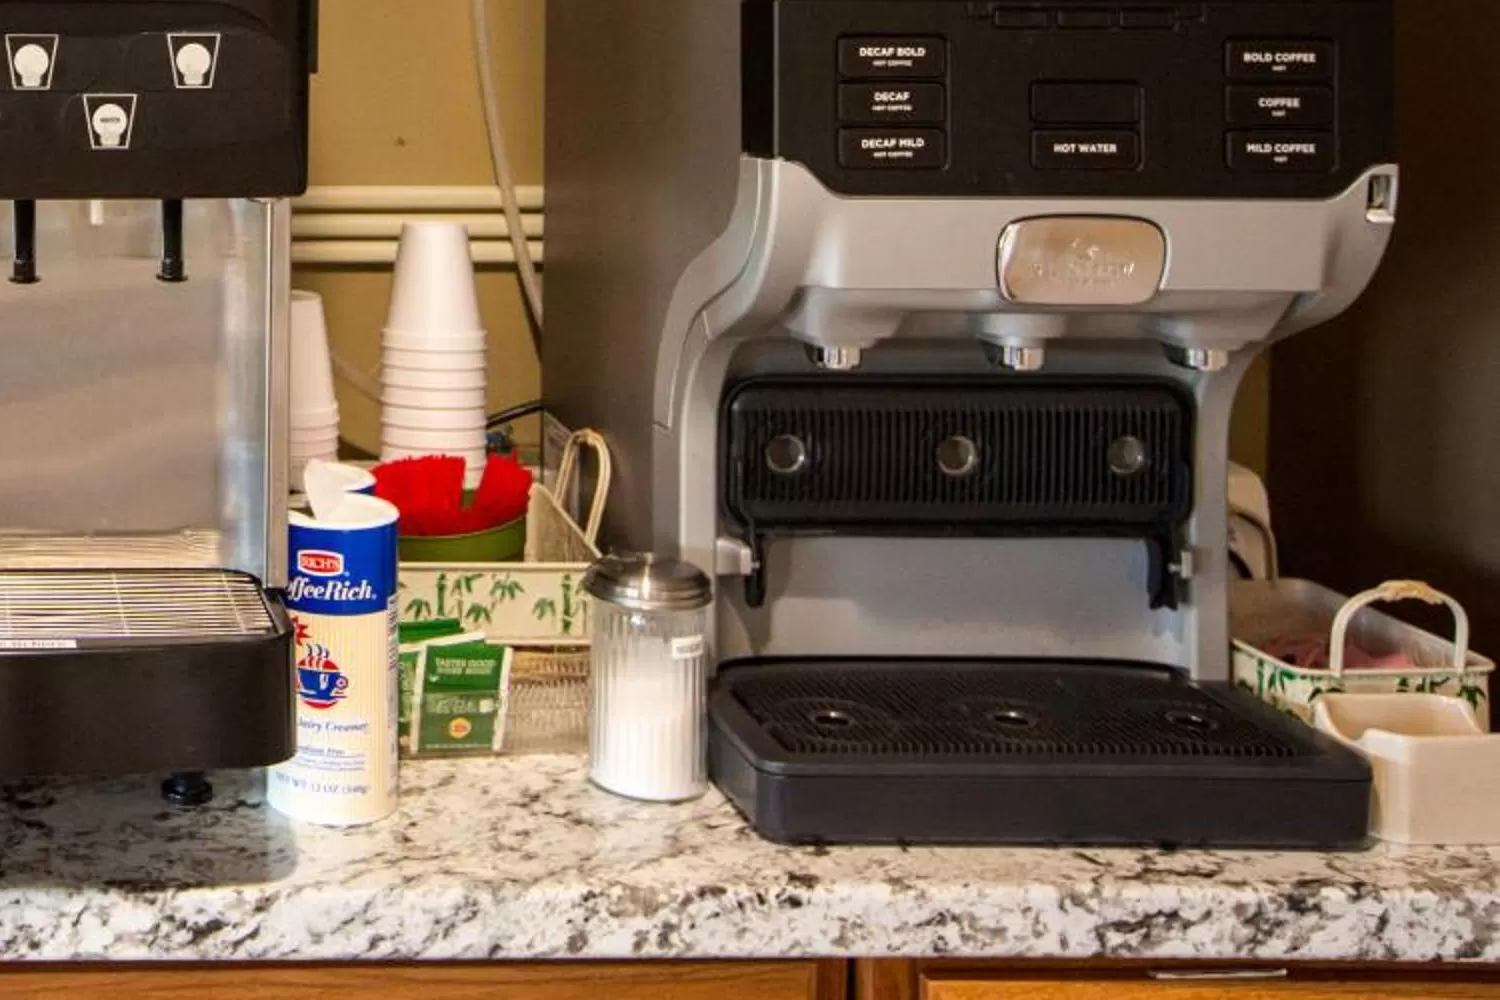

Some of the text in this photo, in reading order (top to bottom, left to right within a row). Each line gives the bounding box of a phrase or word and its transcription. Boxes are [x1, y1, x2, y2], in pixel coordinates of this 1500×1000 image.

[859, 47, 927, 57] DECAF BOLD
[1243, 52, 1317, 63] BOLD COFFEE
[873, 91, 911, 101] DECAF
[1258, 97, 1300, 108] COFFEE
[861, 137, 925, 149] DECAF MILD
[1053, 143, 1118, 153] HOT WATER
[1246, 143, 1317, 154] MILD COFFEE
